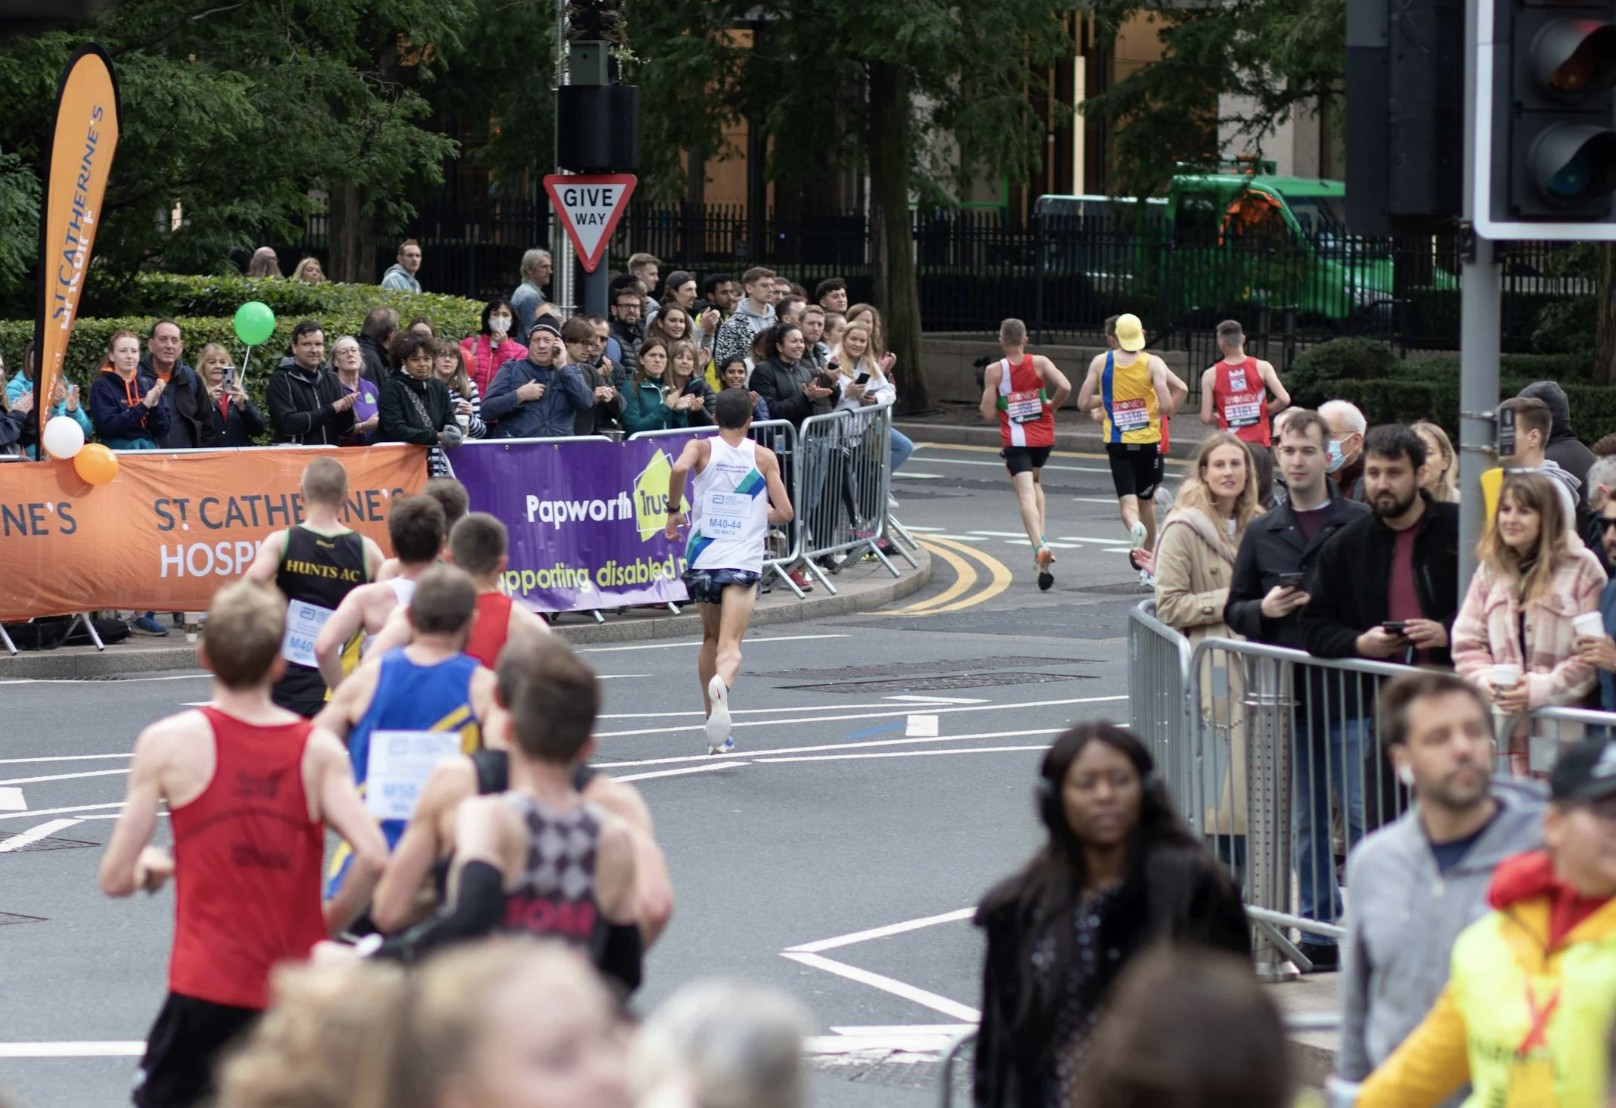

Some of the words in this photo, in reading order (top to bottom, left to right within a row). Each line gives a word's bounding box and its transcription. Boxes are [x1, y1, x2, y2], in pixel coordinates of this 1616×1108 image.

[563, 188, 613, 207] GIVE
[575, 212, 606, 225] WAY
[199, 488, 404, 530] CATHENE'
[526, 491, 632, 530] Papworth
[640, 490, 669, 516] Trus
[709, 517, 742, 529] M40-44
[286, 559, 338, 578] HUNTS
[340, 568, 361, 582] AC
[596, 553, 676, 587] disabled
